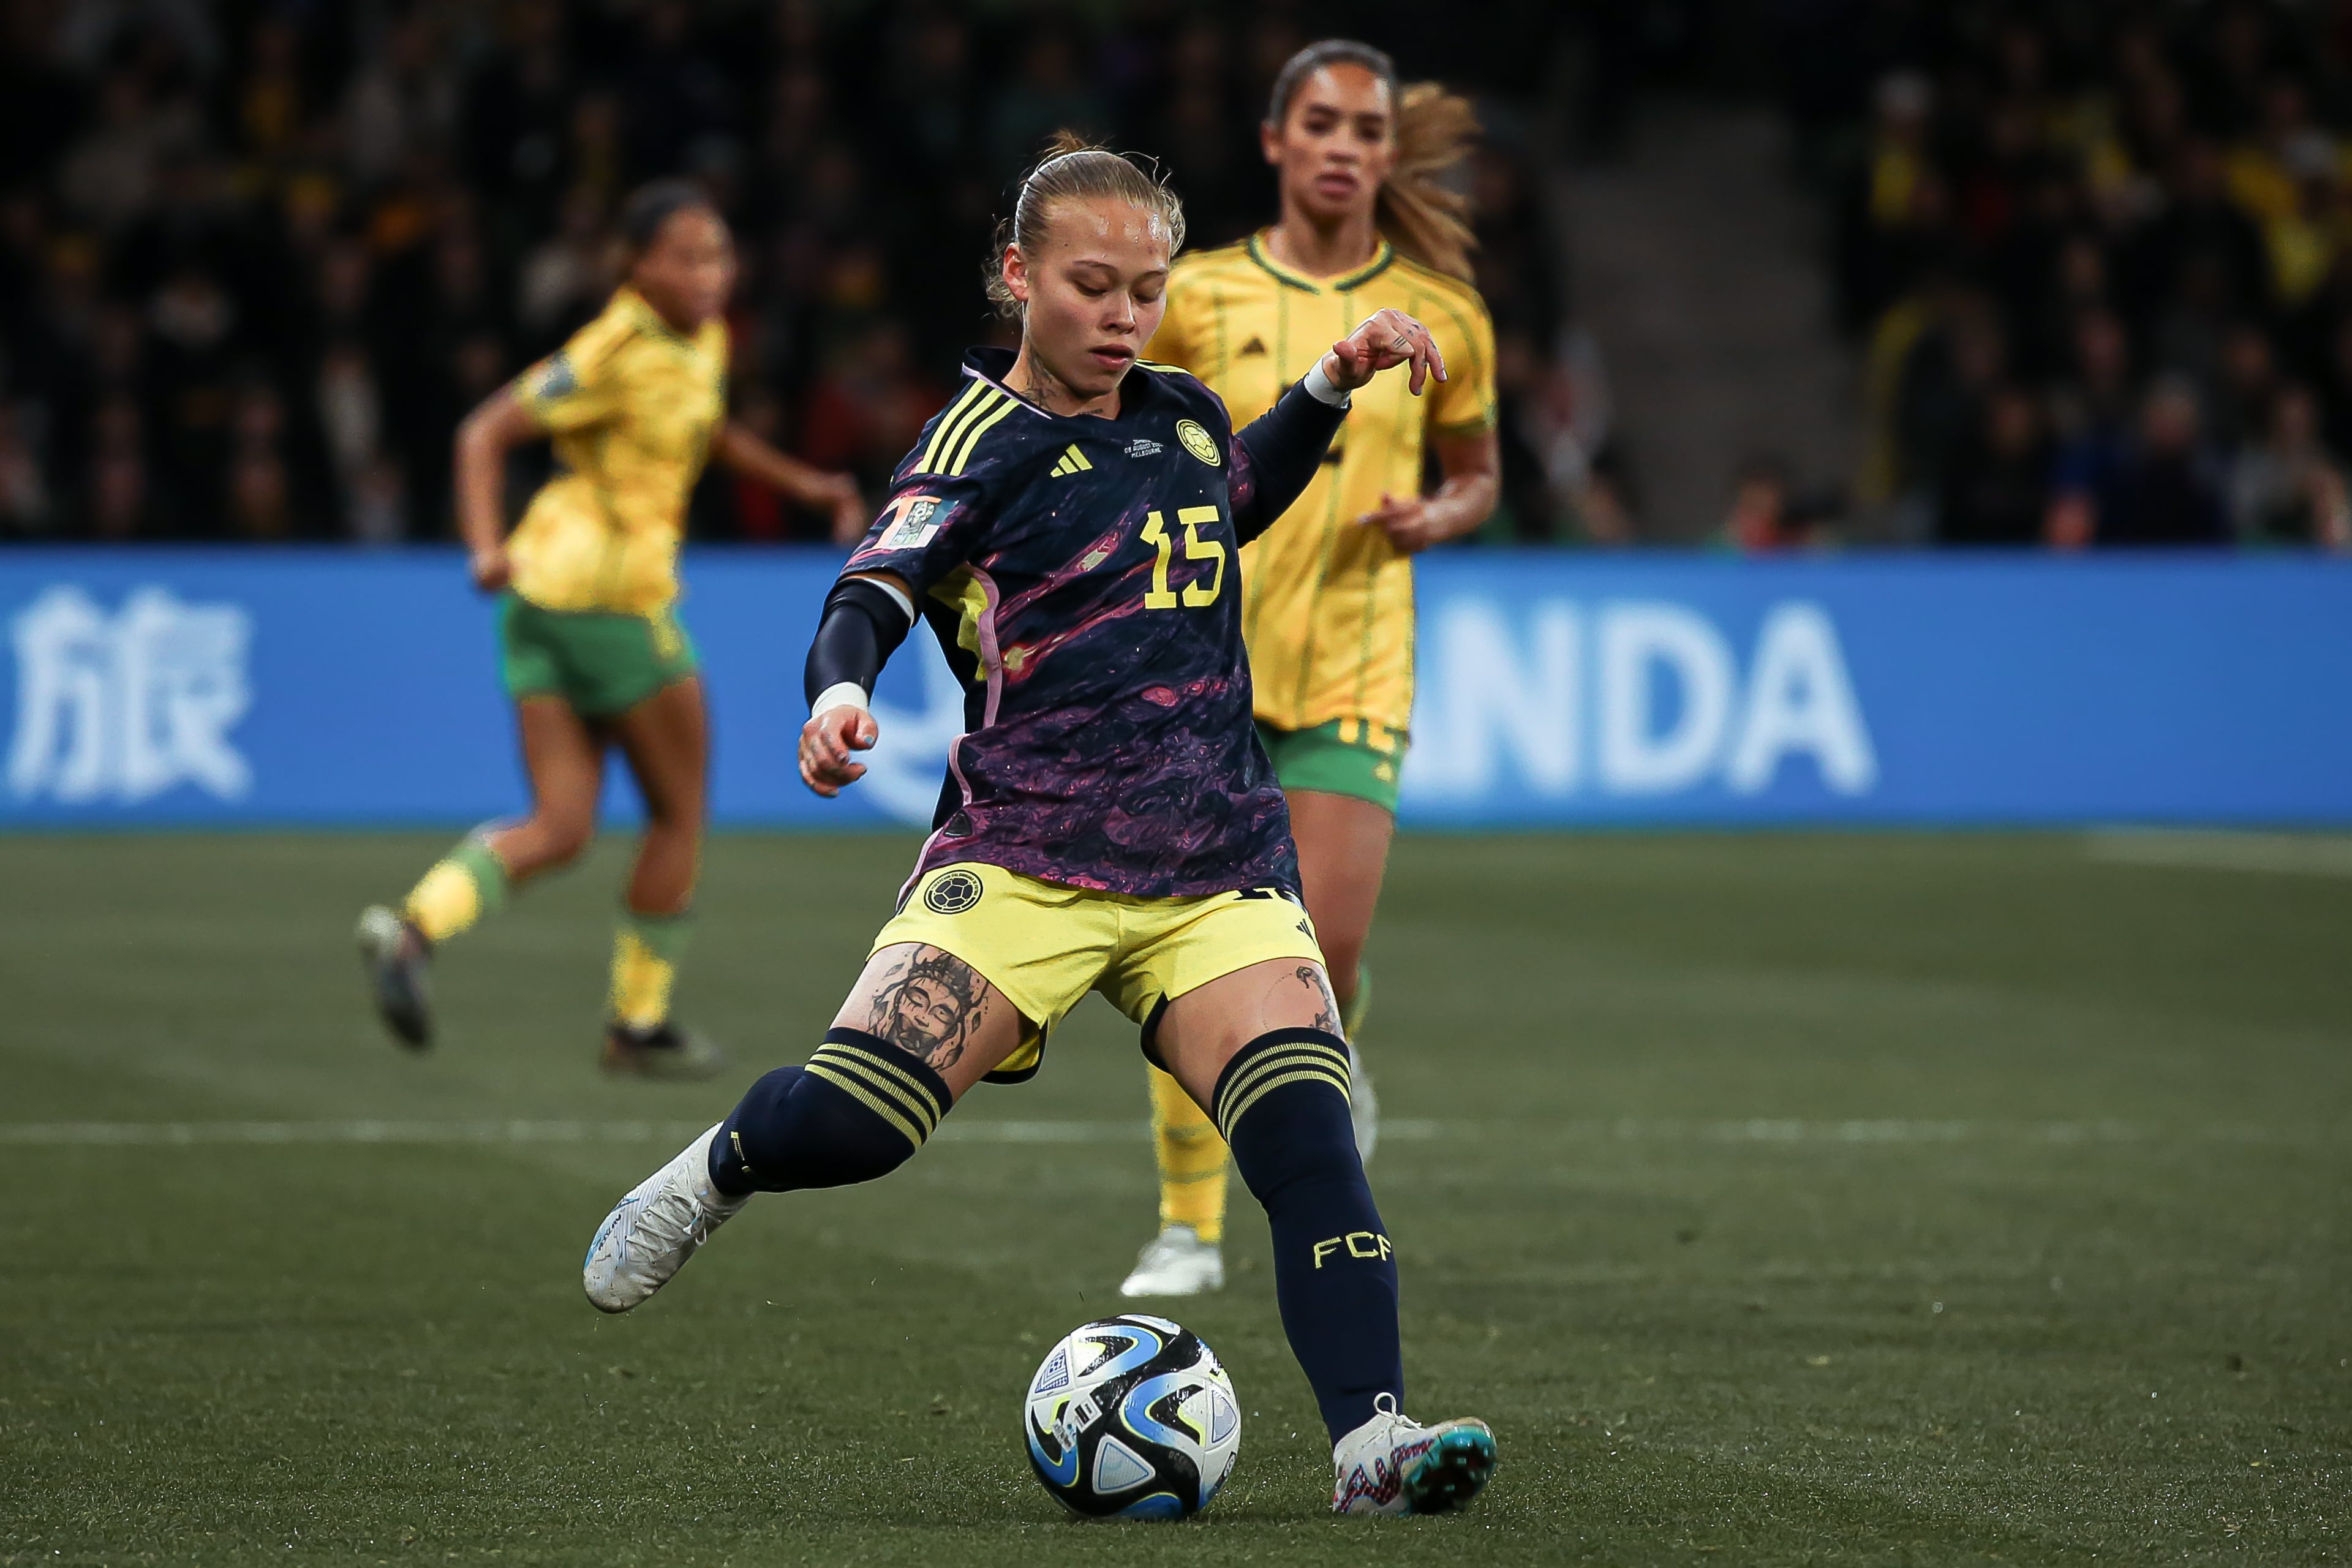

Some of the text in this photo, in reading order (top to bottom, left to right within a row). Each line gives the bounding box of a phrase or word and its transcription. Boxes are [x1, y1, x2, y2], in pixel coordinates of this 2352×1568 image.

[1140, 505, 1225, 609] 15
[1404, 600, 1875, 796] NDA
[1313, 1231, 1391, 1268] FCF
